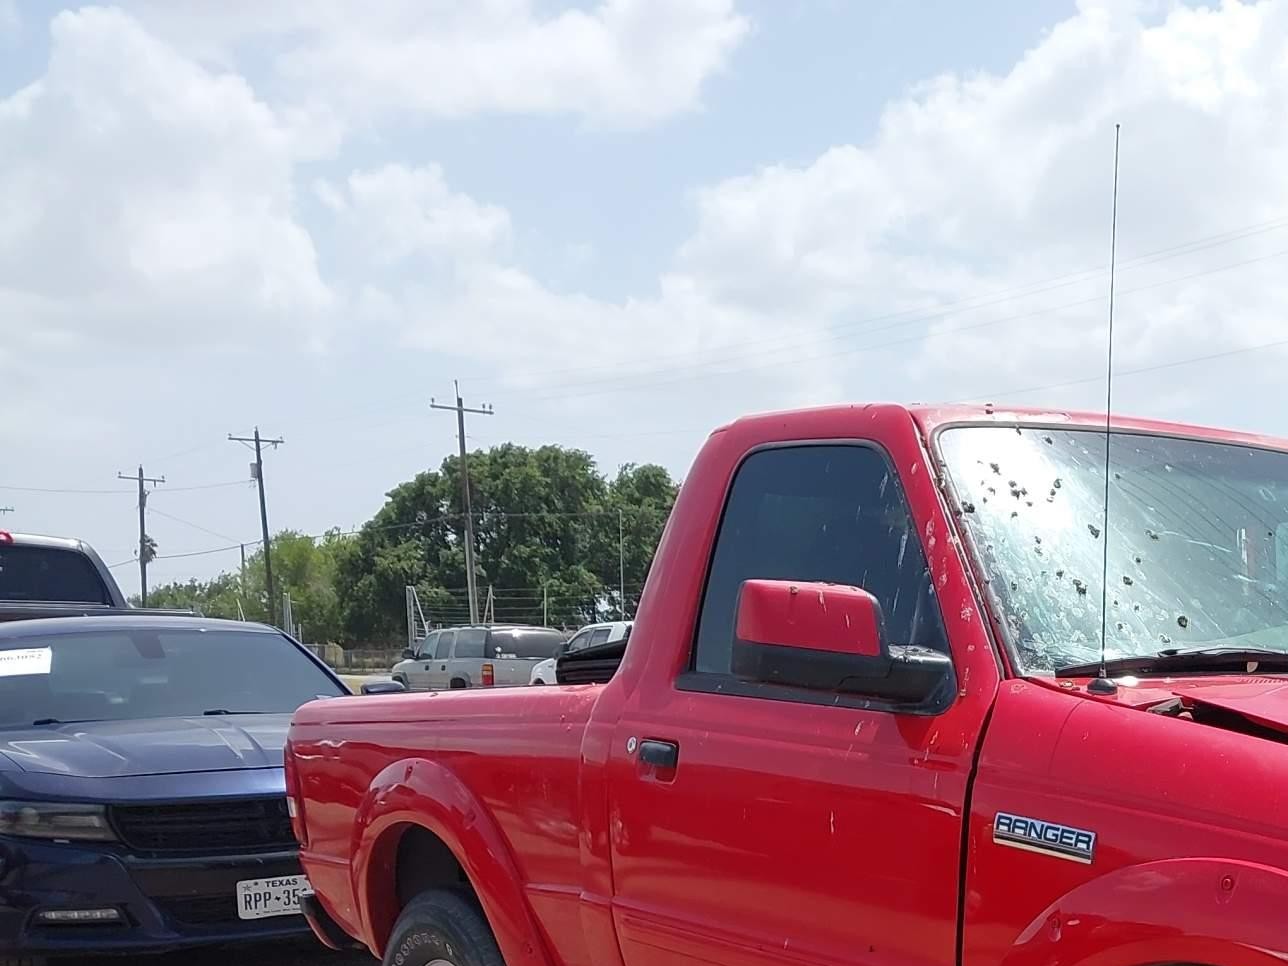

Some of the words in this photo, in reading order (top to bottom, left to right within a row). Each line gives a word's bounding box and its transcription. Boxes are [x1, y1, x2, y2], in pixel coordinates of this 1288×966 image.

[996, 814, 1093, 851] RANGER
[265, 878, 298, 888] TEXAS
[244, 891, 272, 911] RPP
[282, 888, 307, 907] 35
